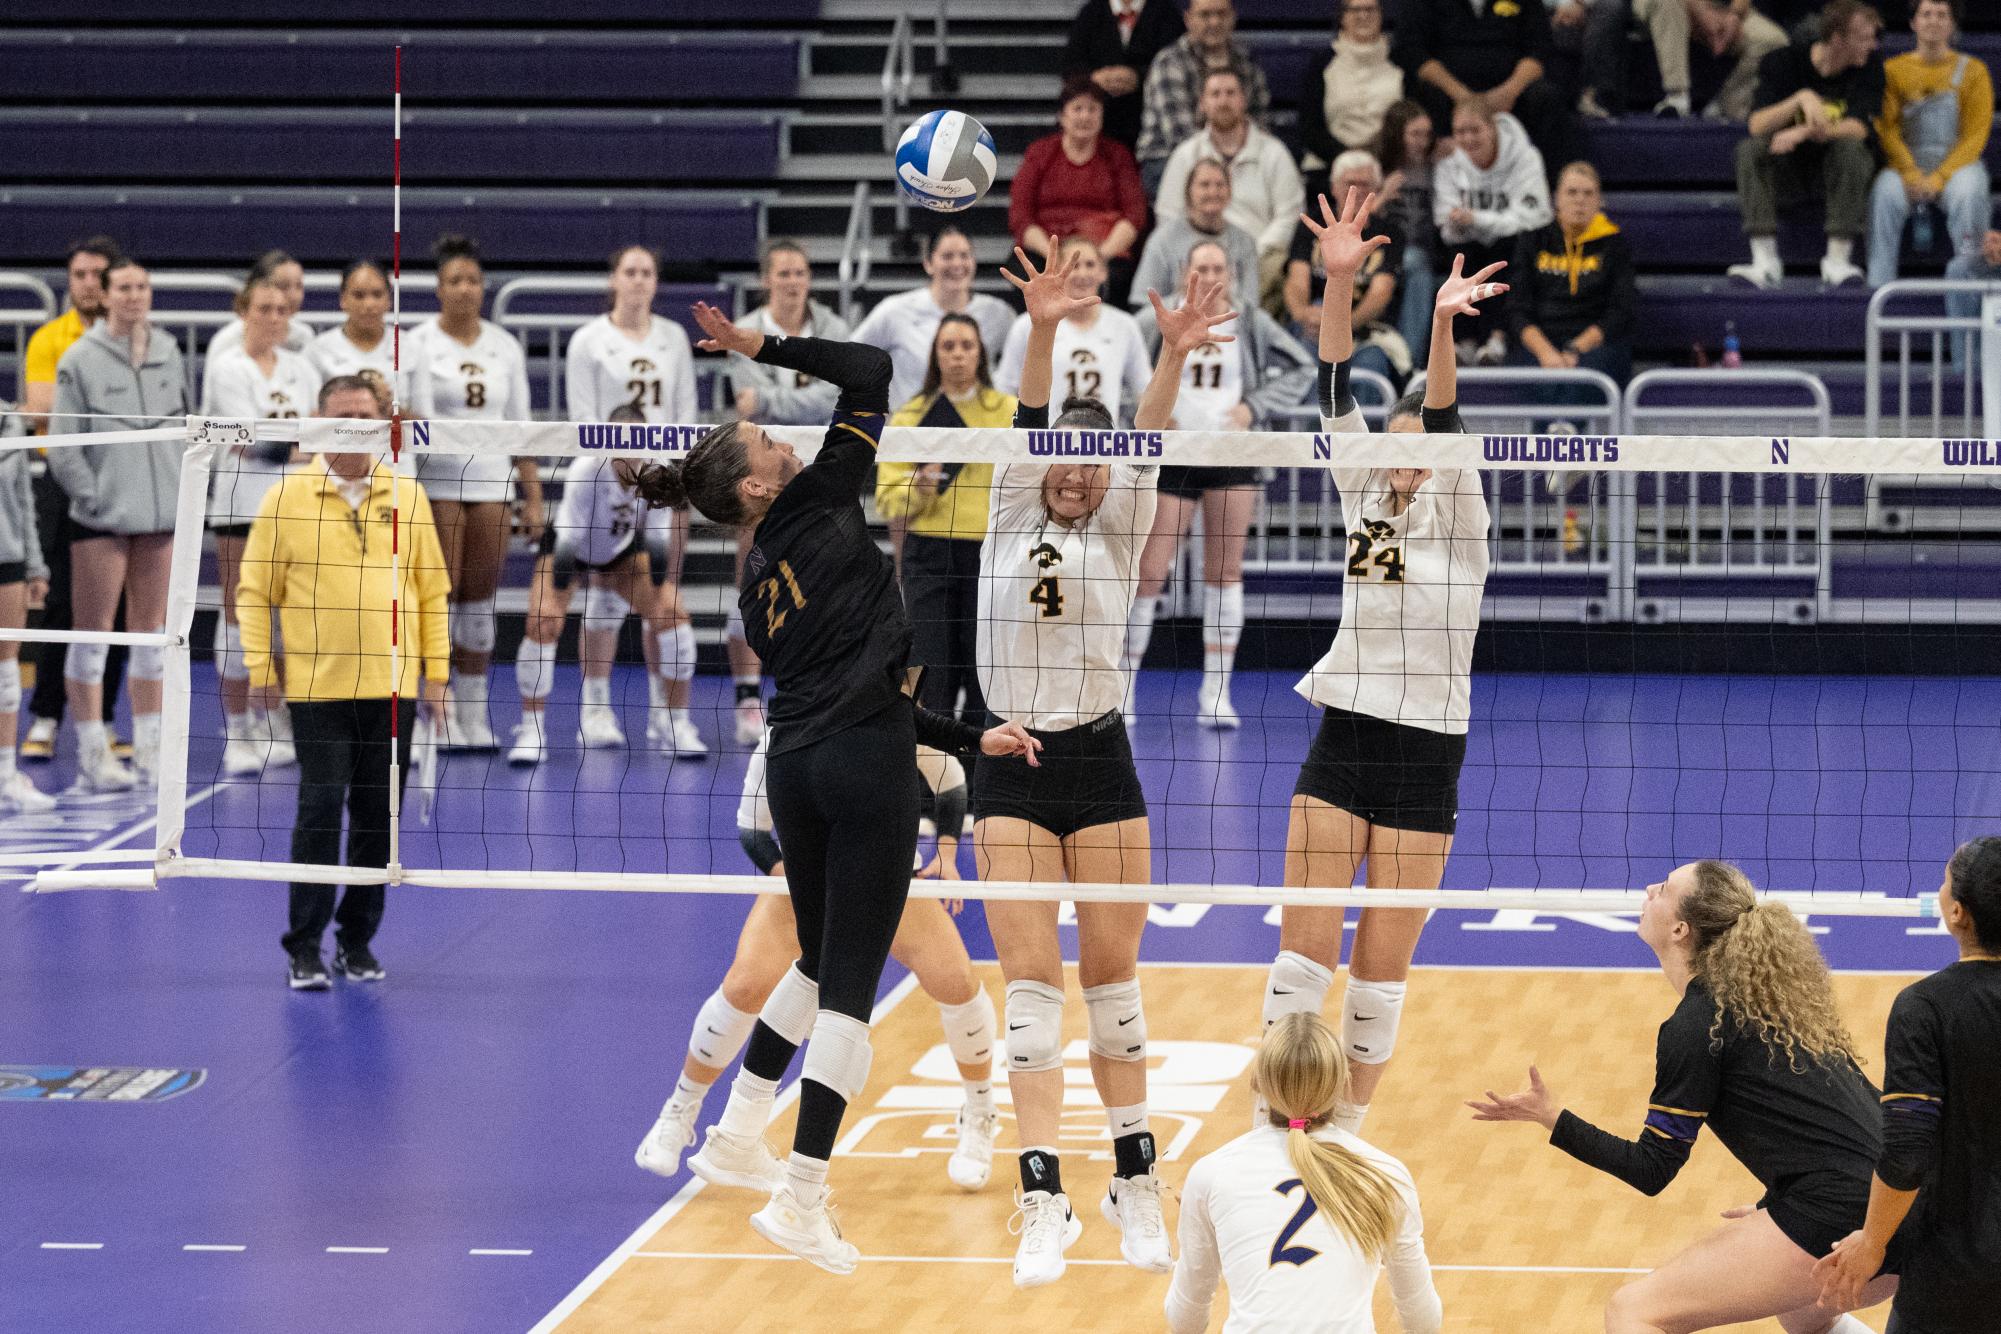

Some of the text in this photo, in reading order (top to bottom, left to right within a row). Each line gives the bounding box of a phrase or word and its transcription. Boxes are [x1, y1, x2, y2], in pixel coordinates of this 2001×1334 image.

[1065, 369, 1102, 398] 12
[1190, 363, 1223, 389] 11
[465, 382, 486, 408] 8
[627, 380, 663, 406] 21
[212, 422, 242, 430] Senoh
[413, 420, 430, 446] N
[1028, 430, 1163, 458] WILDCATS
[1313, 433, 1331, 460] N
[1483, 436, 1619, 463] WILDCATS
[1771, 438, 1789, 465] N
[1347, 531, 1405, 582] 24
[757, 560, 807, 639] 21
[1029, 575, 1065, 618] 4
[1268, 1177, 1324, 1270] 2
